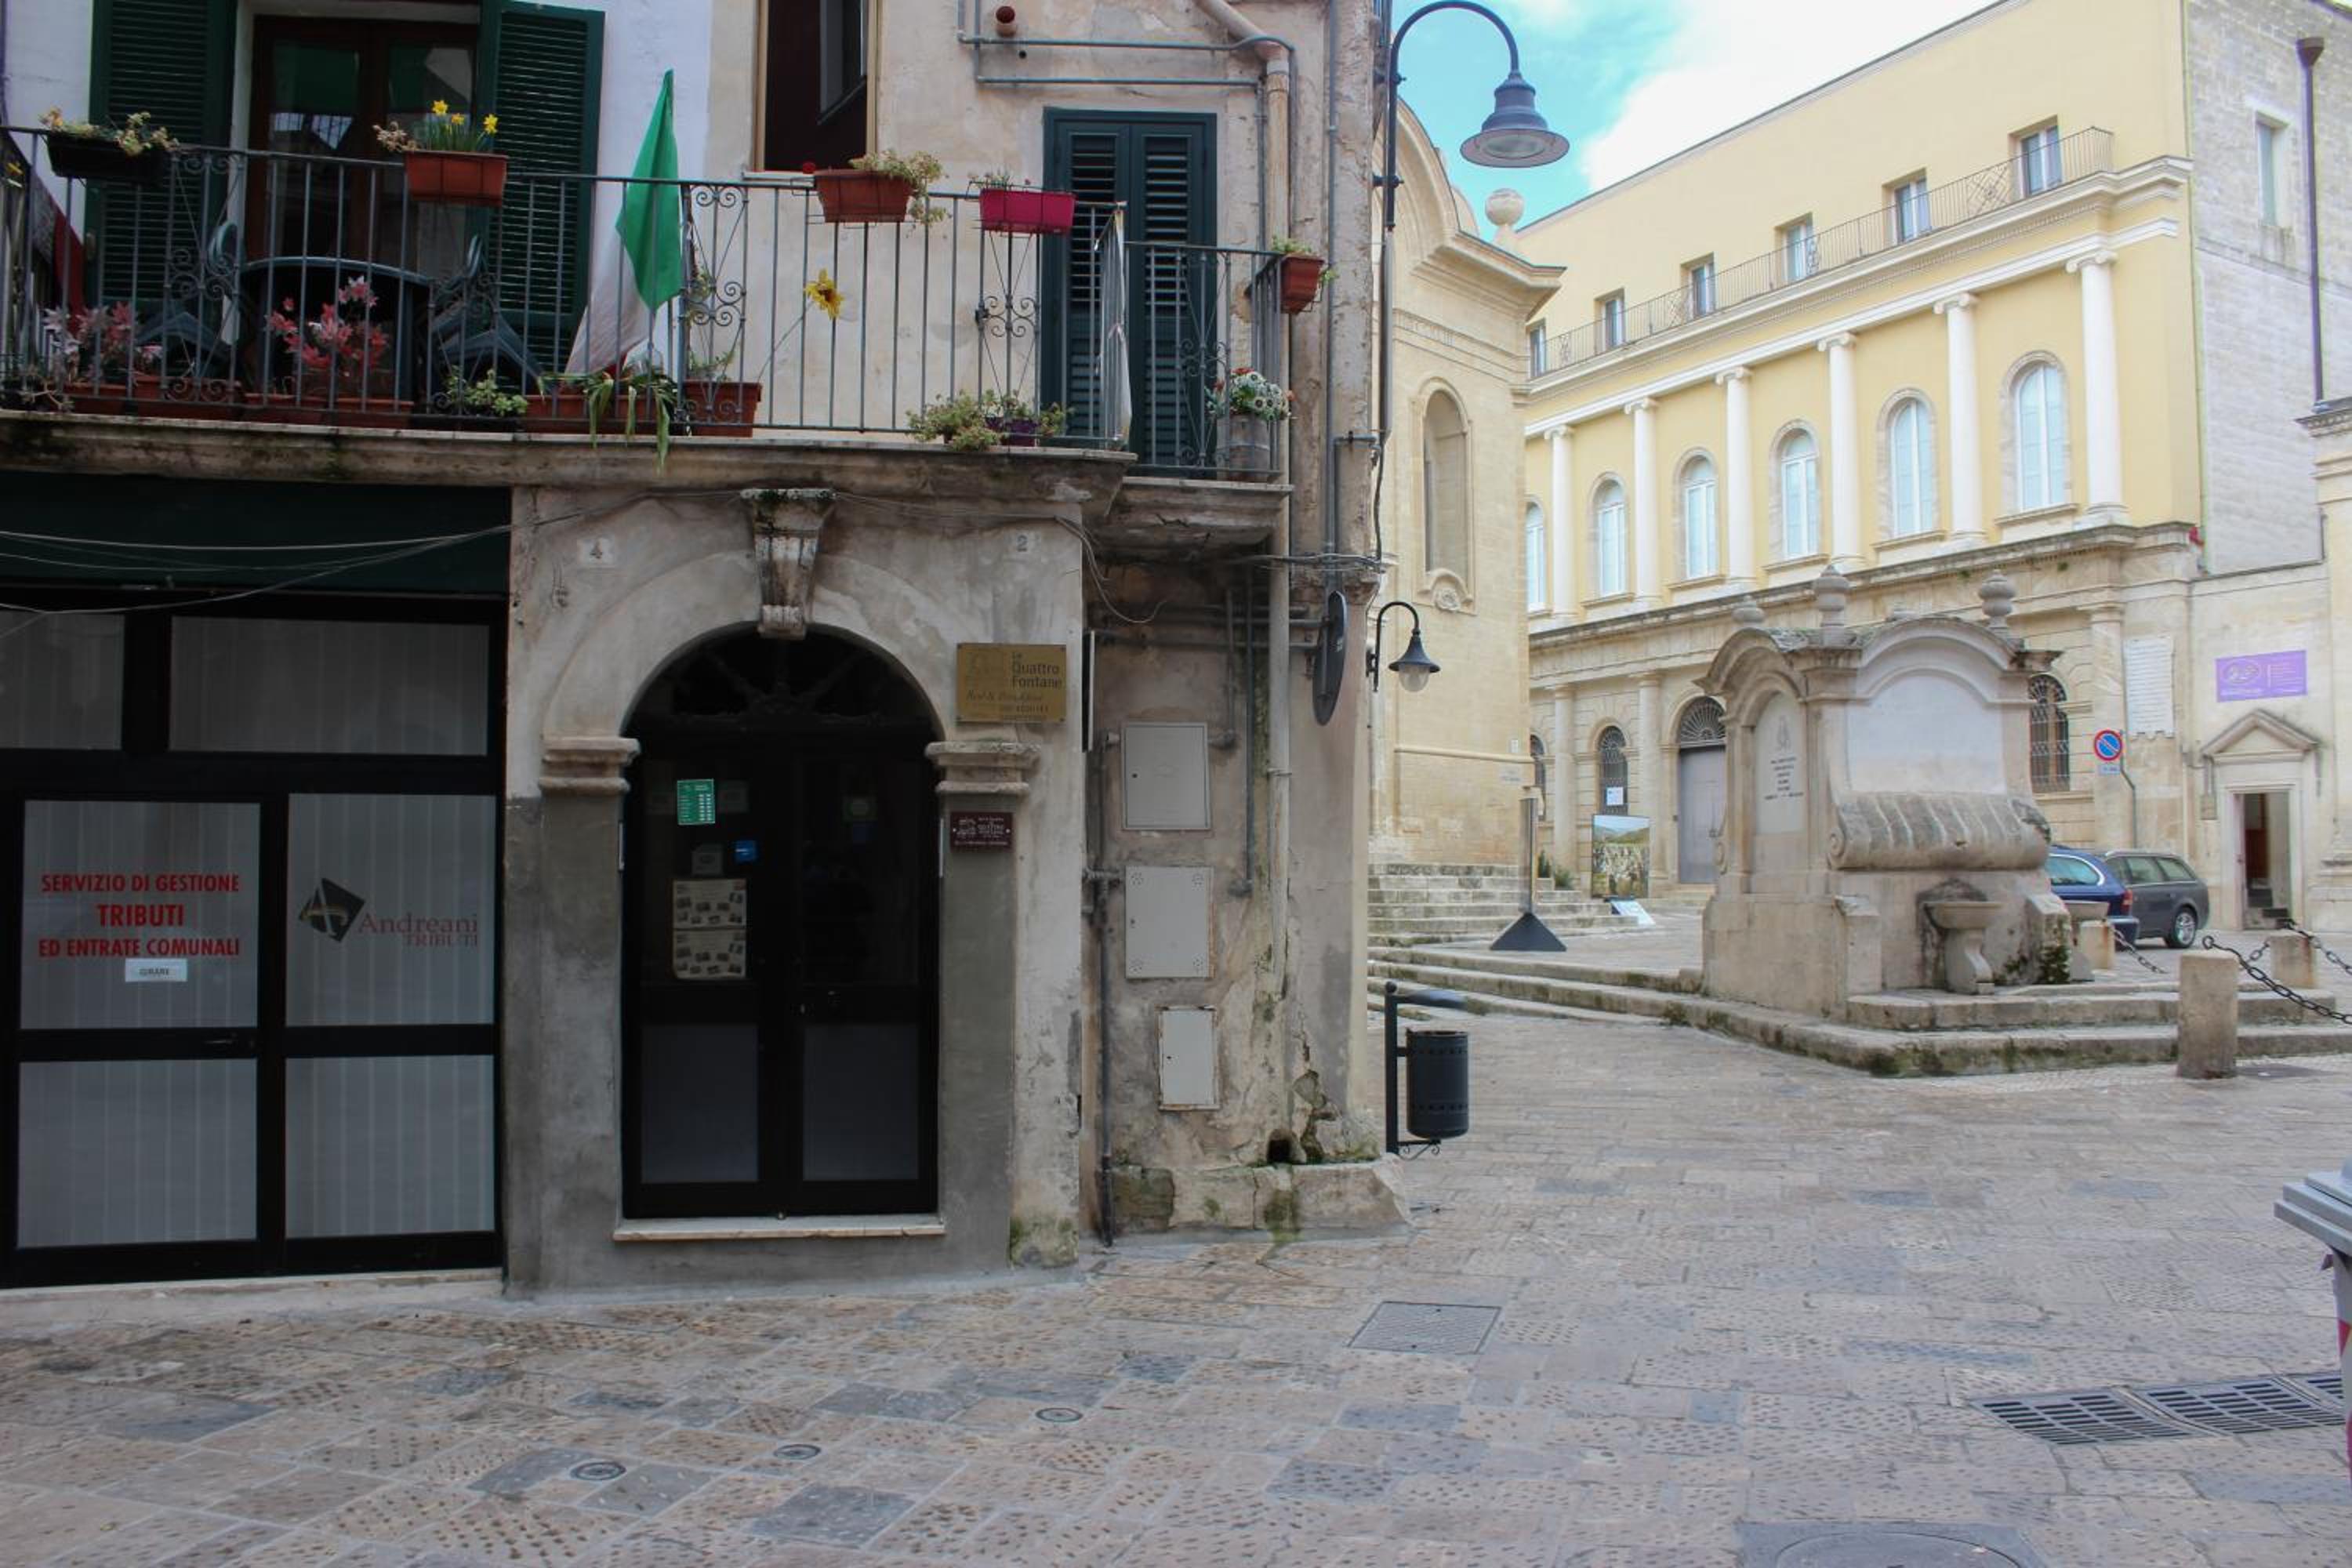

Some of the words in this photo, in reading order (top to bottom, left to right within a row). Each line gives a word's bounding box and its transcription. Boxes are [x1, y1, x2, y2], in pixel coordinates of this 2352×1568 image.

[1017, 535, 1028, 551] 2
[1011, 662, 1060, 675] Quattro
[1011, 676, 1062, 689] Fontane
[42, 875, 125, 892] SERVIZIO
[132, 875, 150, 891] DI
[156, 874, 239, 891] GESTIONE
[97, 904, 183, 927] TRIBUTI
[358, 912, 477, 933] Andreani
[38, 939, 60, 956] ED
[67, 938, 140, 956] ENTRATE
[147, 938, 239, 956] COMUNALI
[404, 934, 477, 947] TRIBUTI
